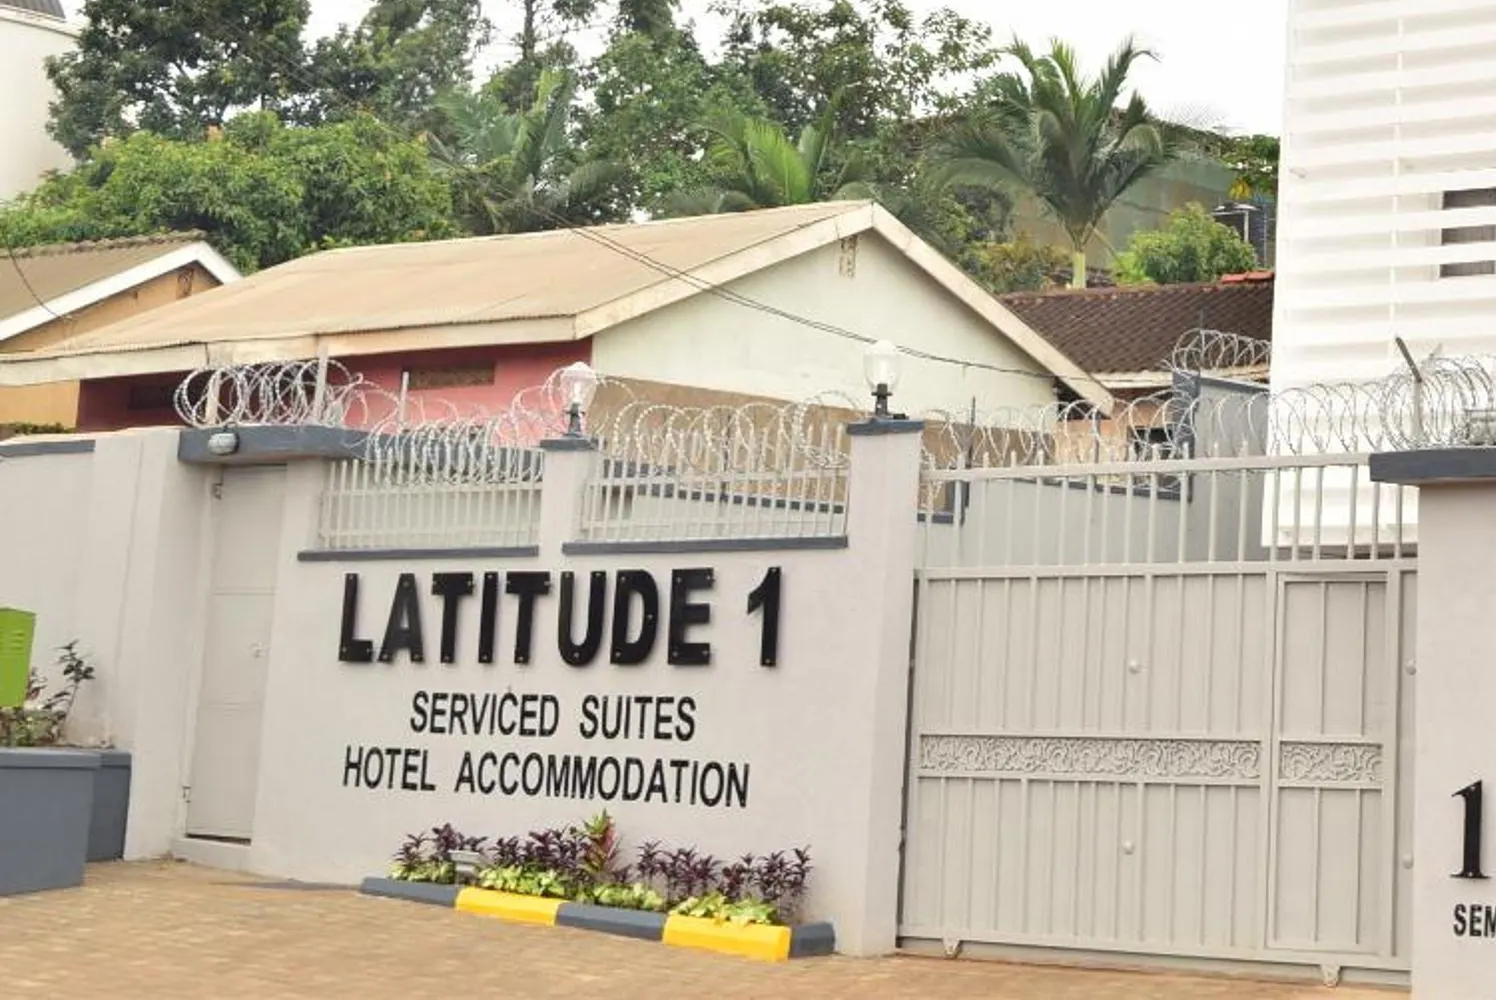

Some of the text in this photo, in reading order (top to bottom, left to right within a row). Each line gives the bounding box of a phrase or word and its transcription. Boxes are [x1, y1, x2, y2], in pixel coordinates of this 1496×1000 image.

[339, 566, 782, 667] LATITUDE 1
[410, 691, 697, 742] SERVICED SUITES
[343, 746, 750, 808] HOTEL ACCOMMODATION
